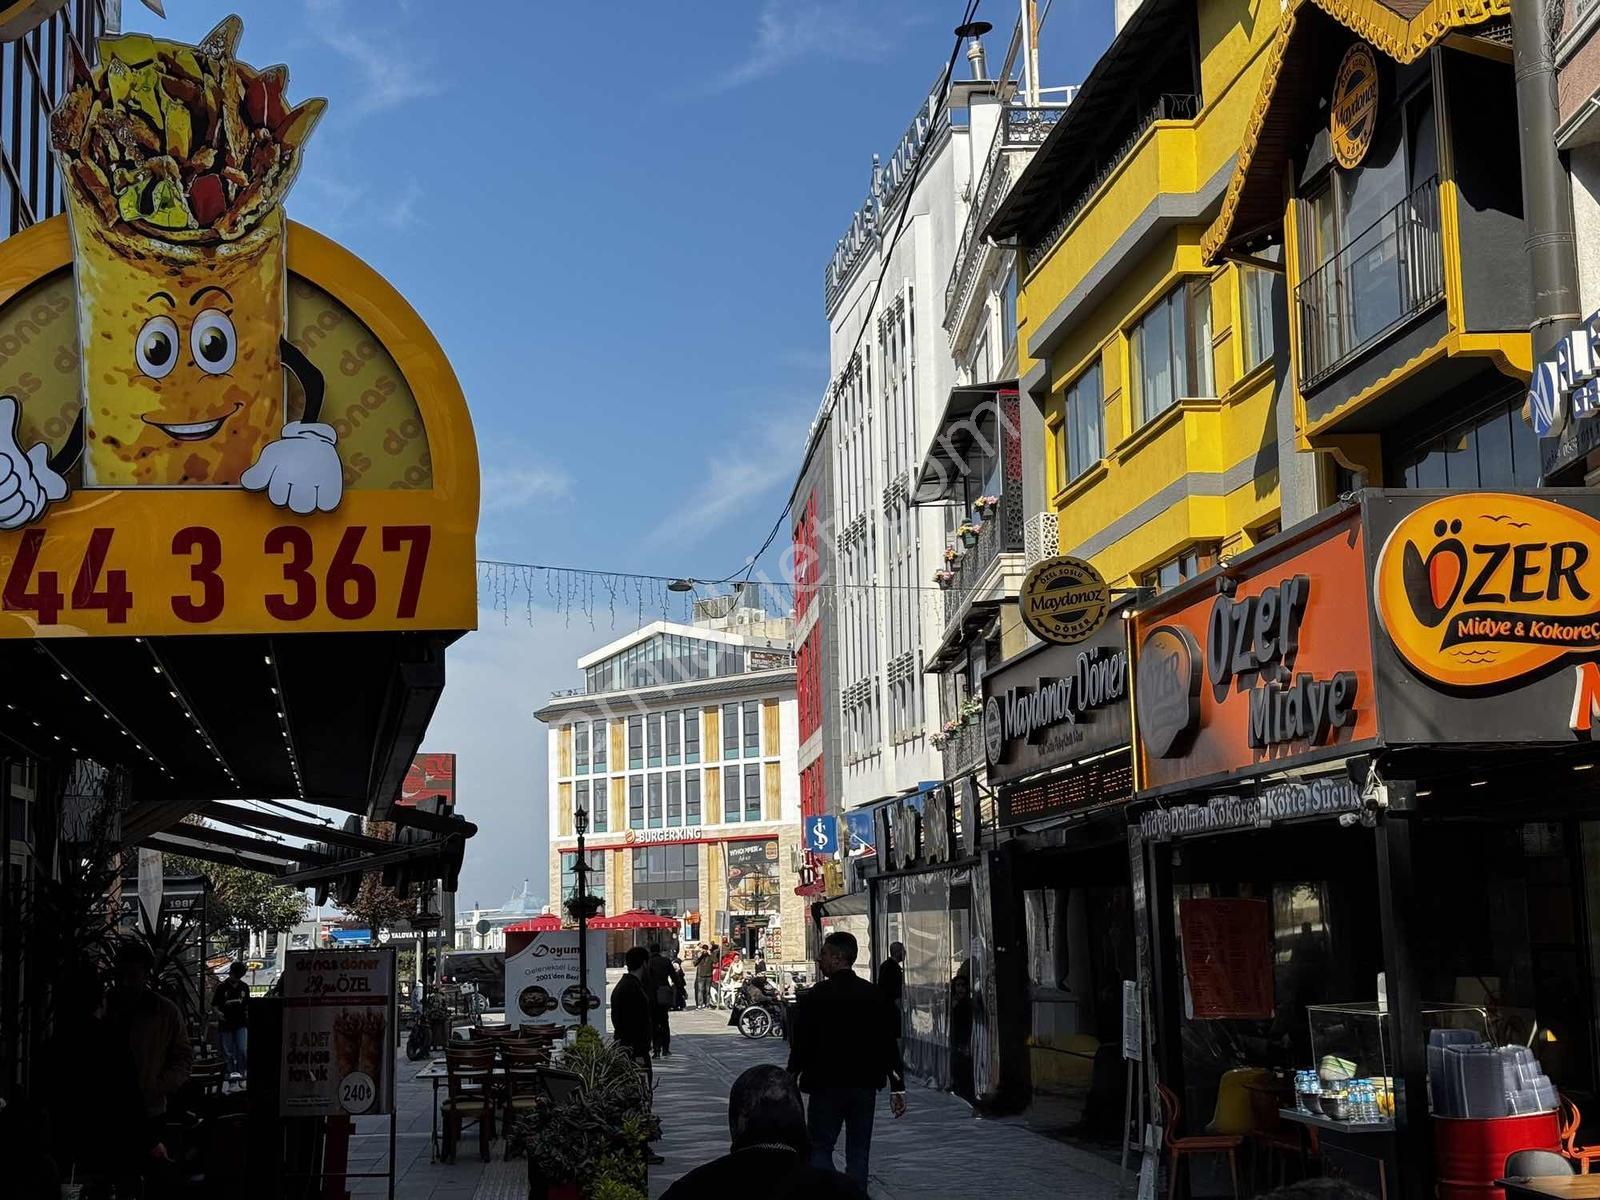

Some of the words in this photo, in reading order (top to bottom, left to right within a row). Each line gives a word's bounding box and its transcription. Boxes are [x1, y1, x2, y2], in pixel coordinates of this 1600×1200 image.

[171, 527, 225, 623] 3
[264, 525, 431, 621] 367
[1403, 518, 1591, 628] ÖZER
[1030, 587, 1106, 612] Maydonoz
[1054, 617, 1091, 633] DÖNER
[1207, 575, 1310, 697] Özer
[1458, 613, 1512, 639] Midye
[1515, 620, 1525, 638] &
[1004, 675, 1075, 746] Maydonoz
[1076, 648, 1128, 711] Döner
[1249, 664, 1358, 750] Midye
[640, 829, 677, 842] BURGER
[677, 826, 702, 840] KING
[1171, 808, 1204, 834] Dolma
[1209, 800, 1260, 828] Kokoreç
[1266, 786, 1305, 818] Köfte
[337, 973, 371, 993] ÖZEL
